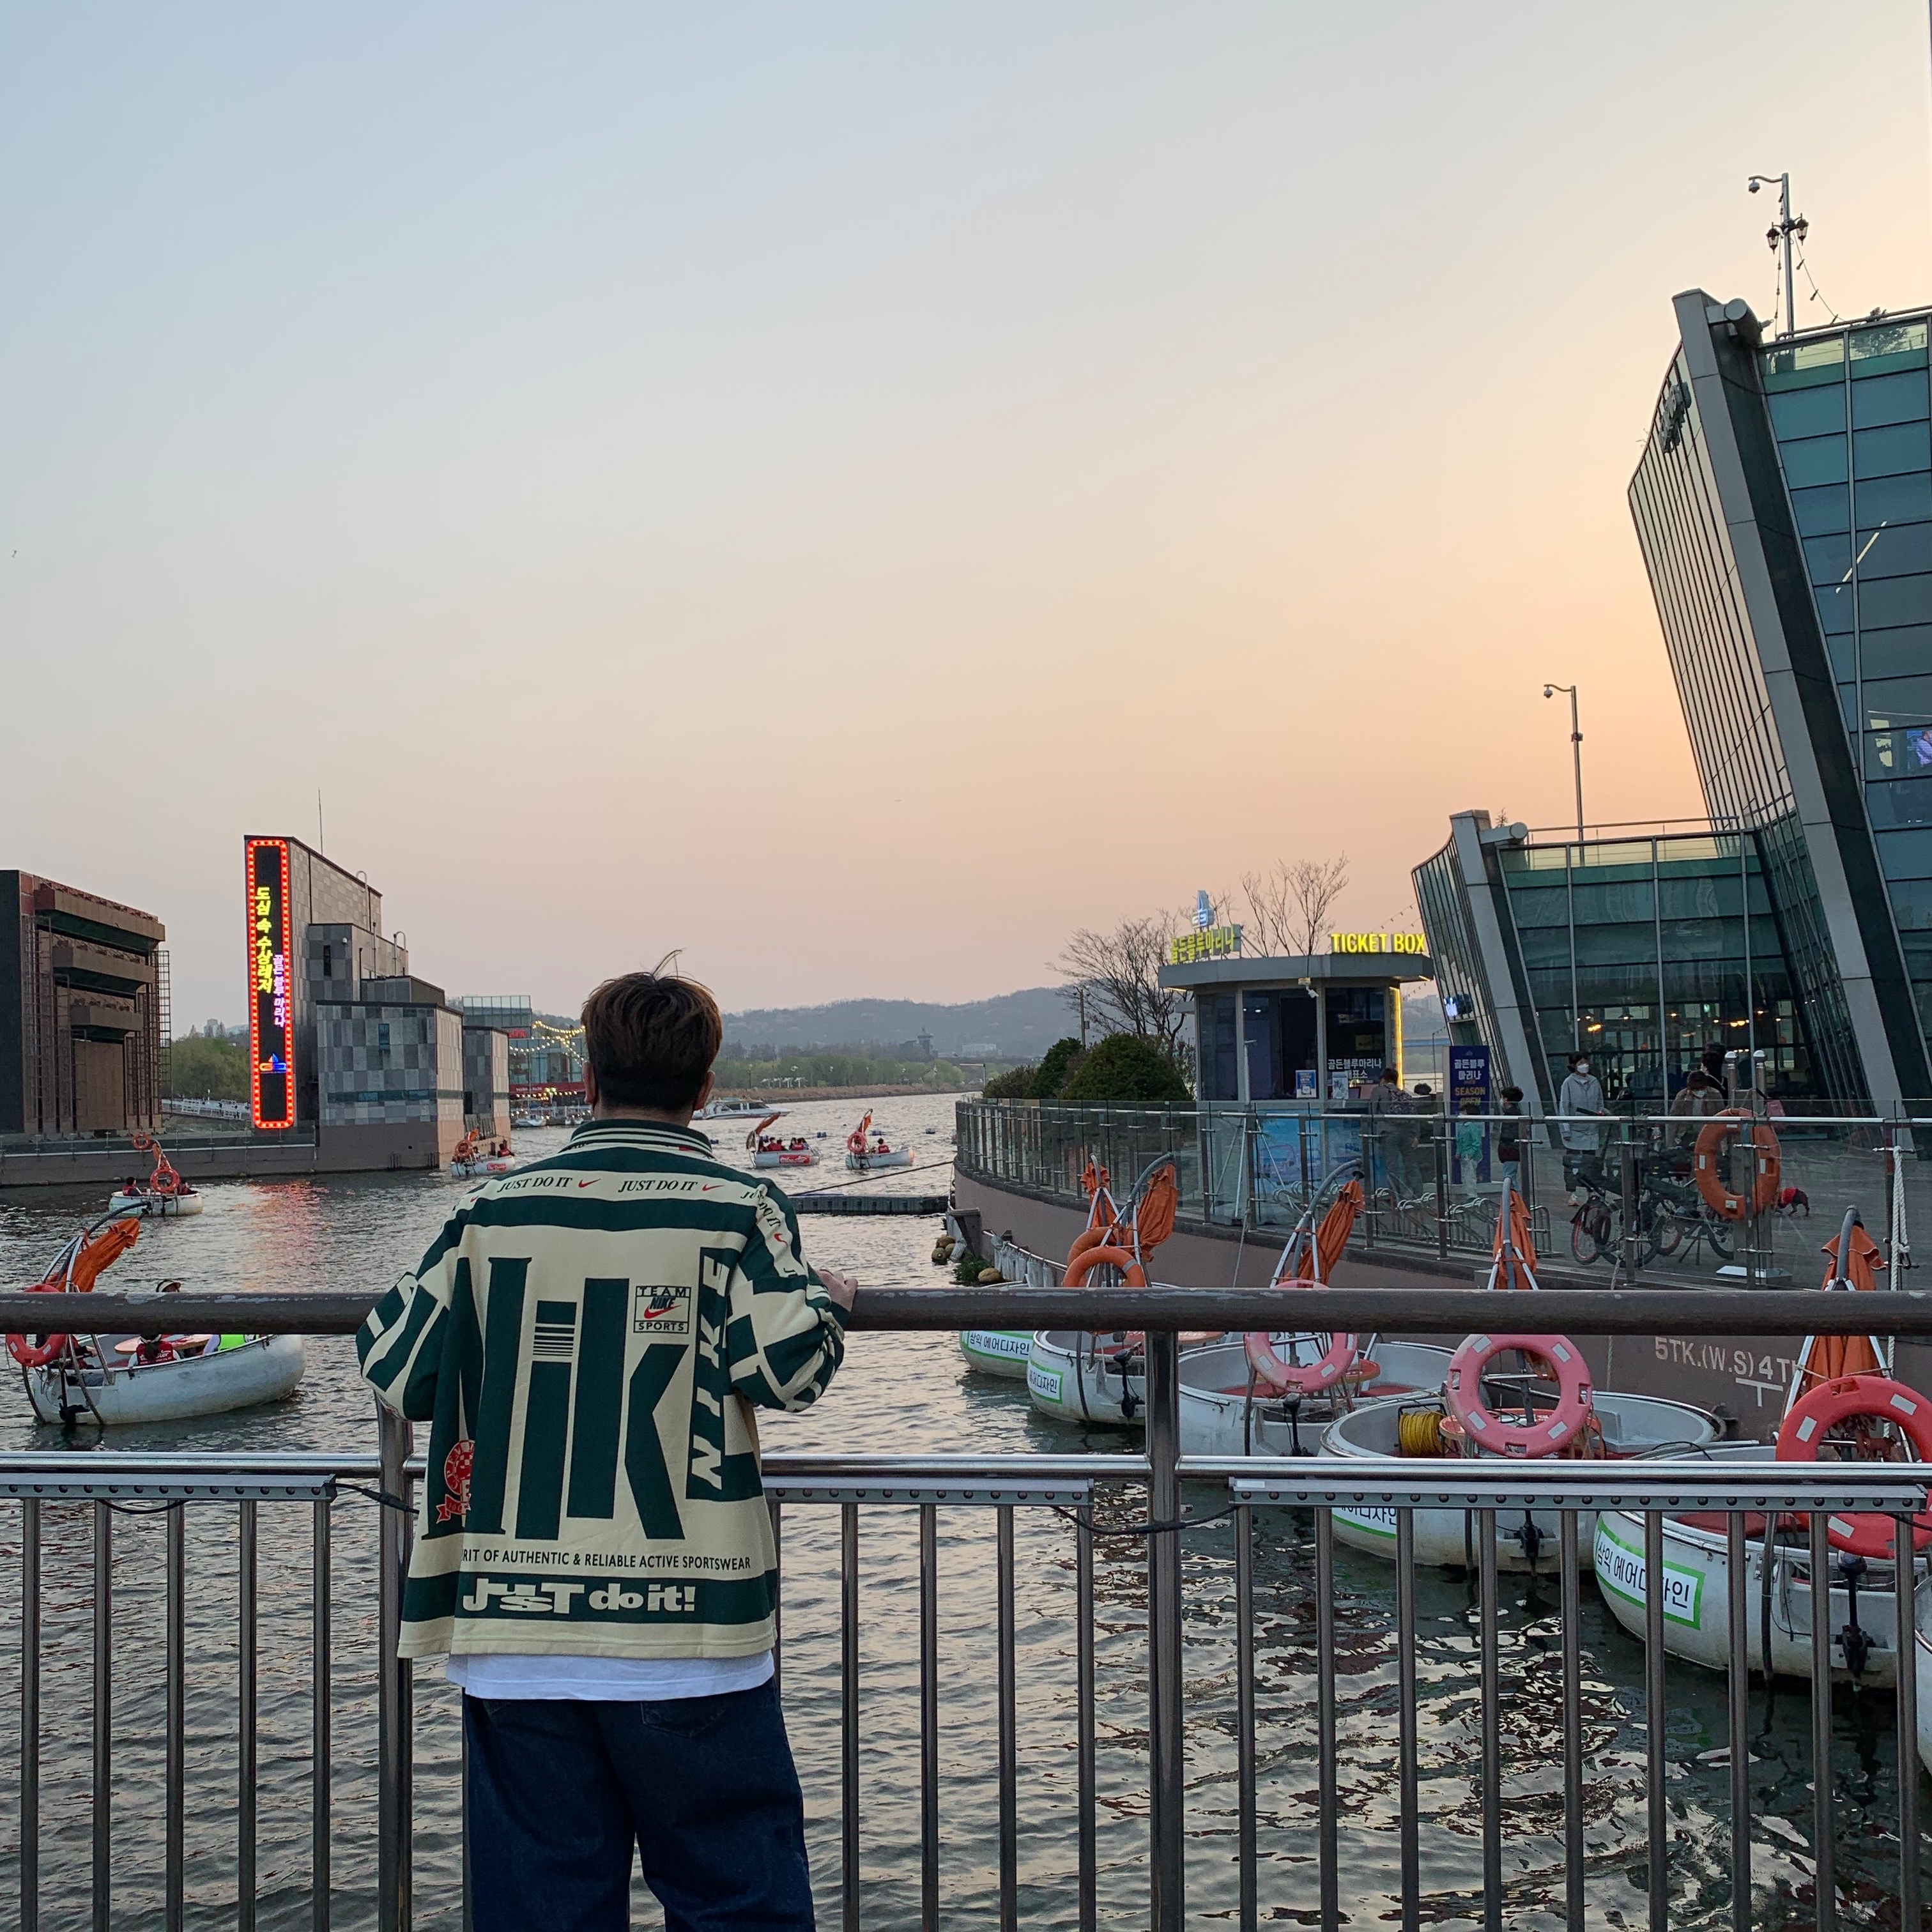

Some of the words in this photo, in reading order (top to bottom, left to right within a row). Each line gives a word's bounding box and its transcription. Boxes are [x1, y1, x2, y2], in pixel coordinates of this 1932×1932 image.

[255, 887, 271, 916] 도심
[1331, 933, 1388, 953] TICKET
[1393, 933, 1426, 954] BOX
[1328, 1058, 1382, 1070] 골든블루마리나
[1459, 1071, 1482, 1080] 마리나
[1455, 1087, 1486, 1096] SEASON
[497, 1178, 532, 1193] JUST
[532, 1176, 554, 1187] DO
[555, 1177, 572, 1188] IT
[618, 1180, 656, 1193] JUST
[656, 1180, 678, 1190] DO
[680, 1181, 698, 1191] IT
[640, 1287, 687, 1296] TEAM
[648, 1296, 676, 1309] NIKE
[639, 1322, 684, 1331] SPORTS
[984, 1336, 1030, 1356] 에어디자인
[691, 1255, 730, 1490] NIKE
[484, 1549, 499, 1561] OF
[502, 1550, 569, 1565] AUTHENTIC
[573, 1553, 580, 1565] &
[585, 1554, 636, 1567] RELIABLE
[640, 1555, 678, 1568] ACTIVE
[683, 1556, 751, 1570] SPORTSWEAR
[1598, 1542, 1613, 1574] 삼익
[588, 1583, 644, 1611] do
[647, 1584, 696, 1611] it!
